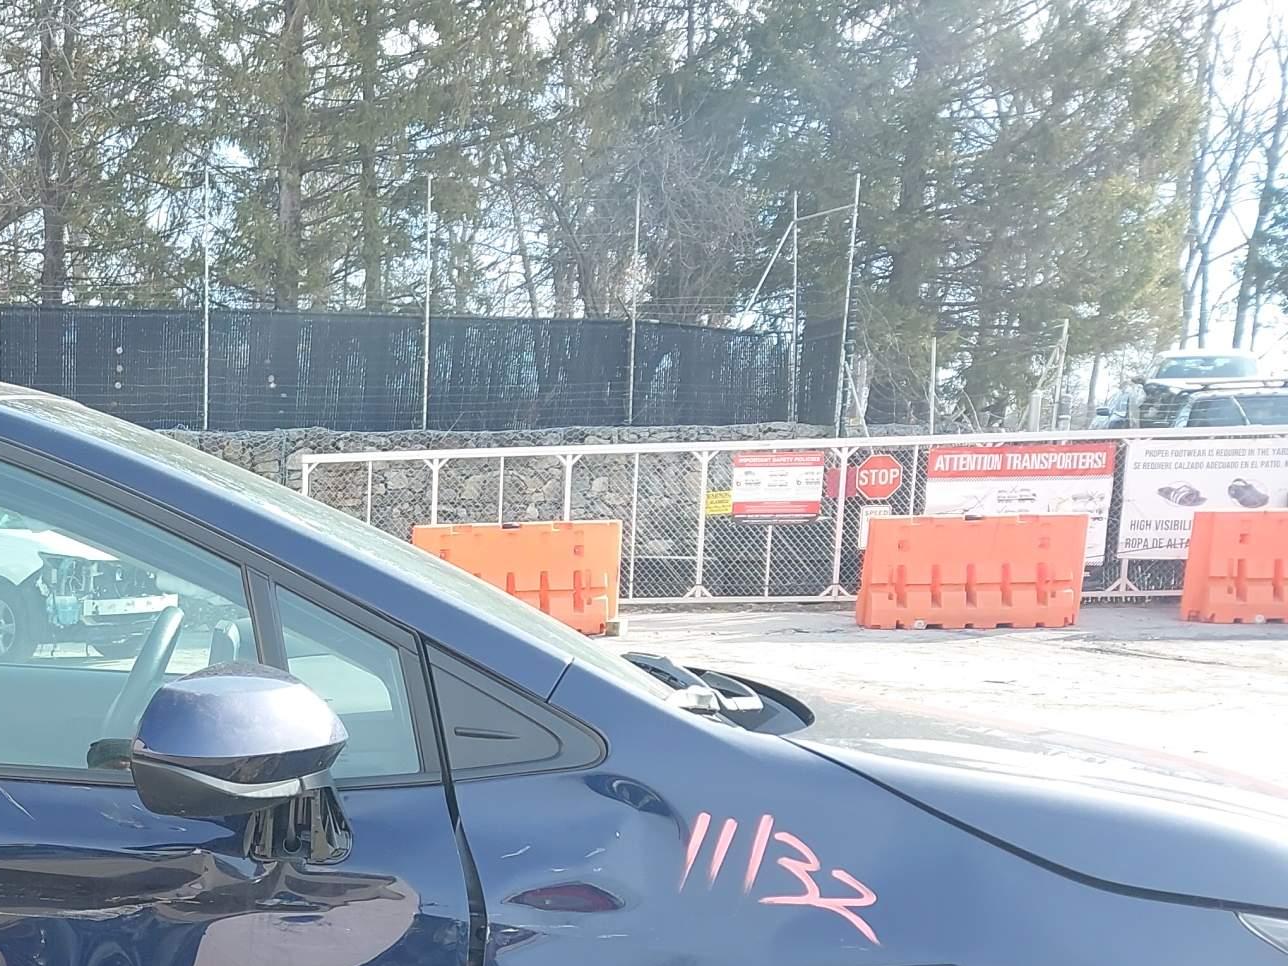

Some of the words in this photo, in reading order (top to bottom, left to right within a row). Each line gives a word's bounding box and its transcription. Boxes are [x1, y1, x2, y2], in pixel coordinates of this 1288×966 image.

[1144, 449, 1170, 457] PROPER
[1171, 448, 1206, 457] FOOTWEAR
[1208, 448, 1214, 456] IS
[1216, 448, 1247, 456] REQUIRED
[1248, 448, 1255, 456] IN
[1257, 447, 1269, 456] THE
[934, 453, 1003, 472] ATTENTION
[1006, 451, 1108, 471] TRANSPORTERS!
[1133, 461, 1141, 470] SE
[1174, 461, 1204, 470] CALZADO
[1240, 460, 1249, 469] EN
[1250, 460, 1258, 469] EL
[859, 468, 899, 486] STOP
[1130, 519, 1152, 531] HIGH
[1124, 537, 1149, 549] ROPA
[1152, 537, 1164, 549] DE
